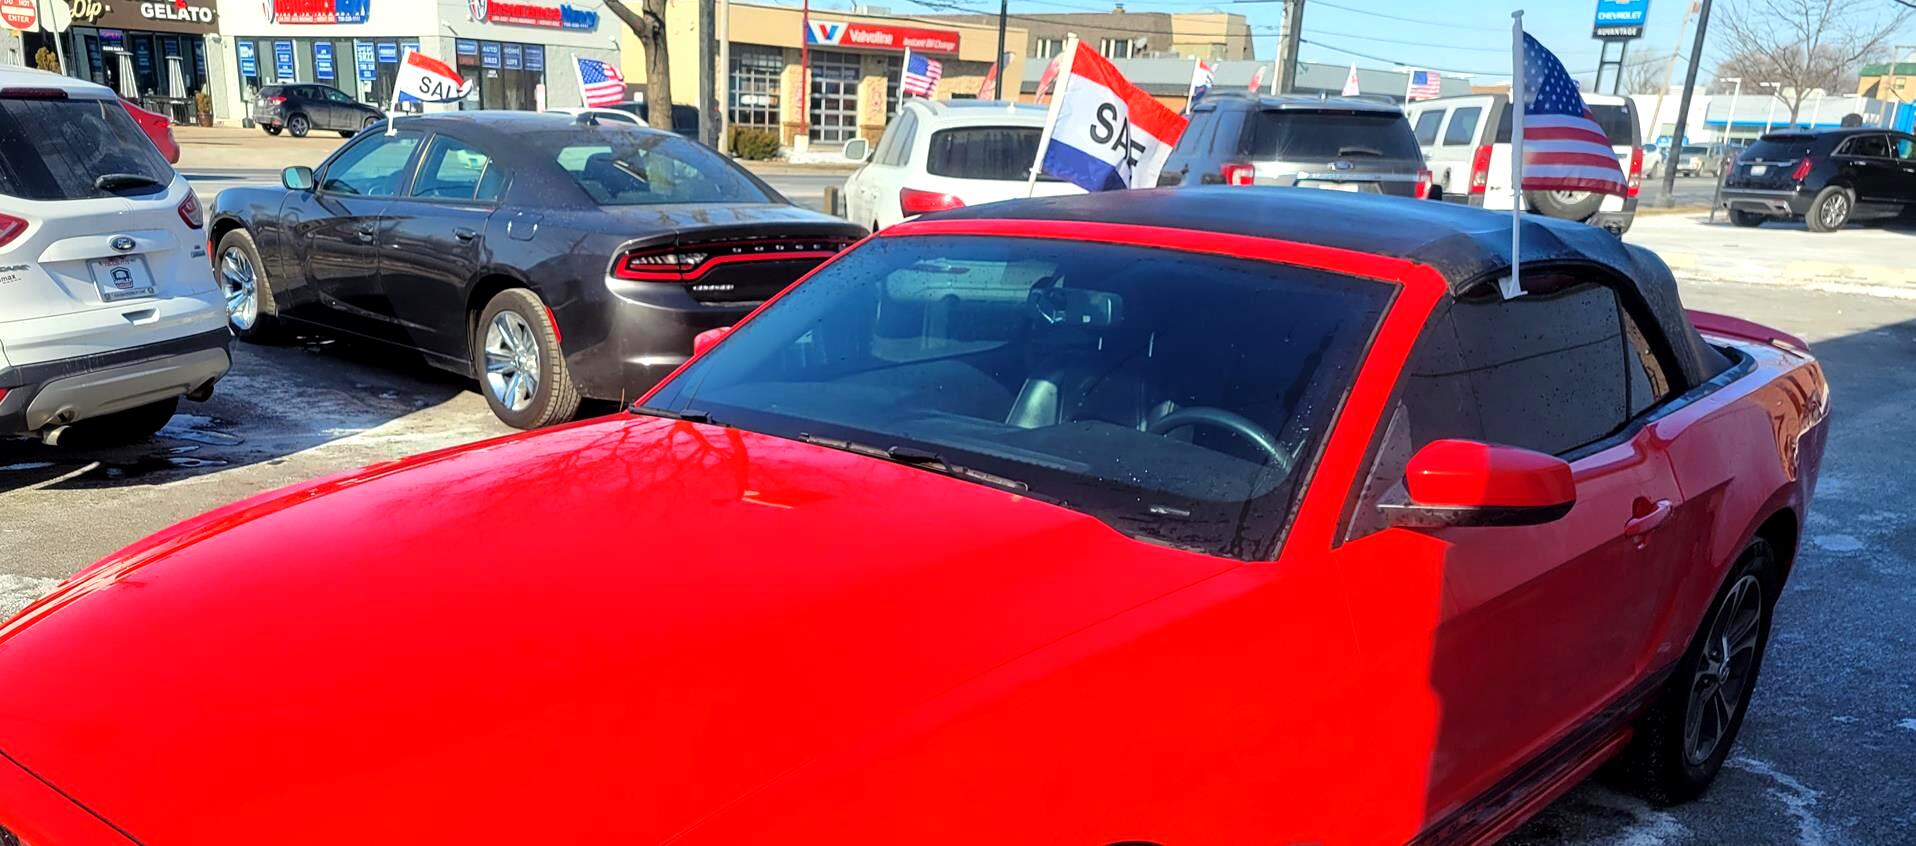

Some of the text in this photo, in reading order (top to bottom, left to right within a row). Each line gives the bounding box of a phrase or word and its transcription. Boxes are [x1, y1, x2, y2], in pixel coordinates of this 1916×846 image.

[141, 2, 213, 23] GELATO
[487, 0, 561, 20] Insurance
[1598, 11, 1642, 20] CHEVROLET
[8, 14, 30, 23] ENTER
[850, 29, 893, 44] Valvoline
[1597, 27, 1637, 36] ADVANTAGE
[903, 37, 926, 47] Instant
[934, 40, 956, 50] Change
